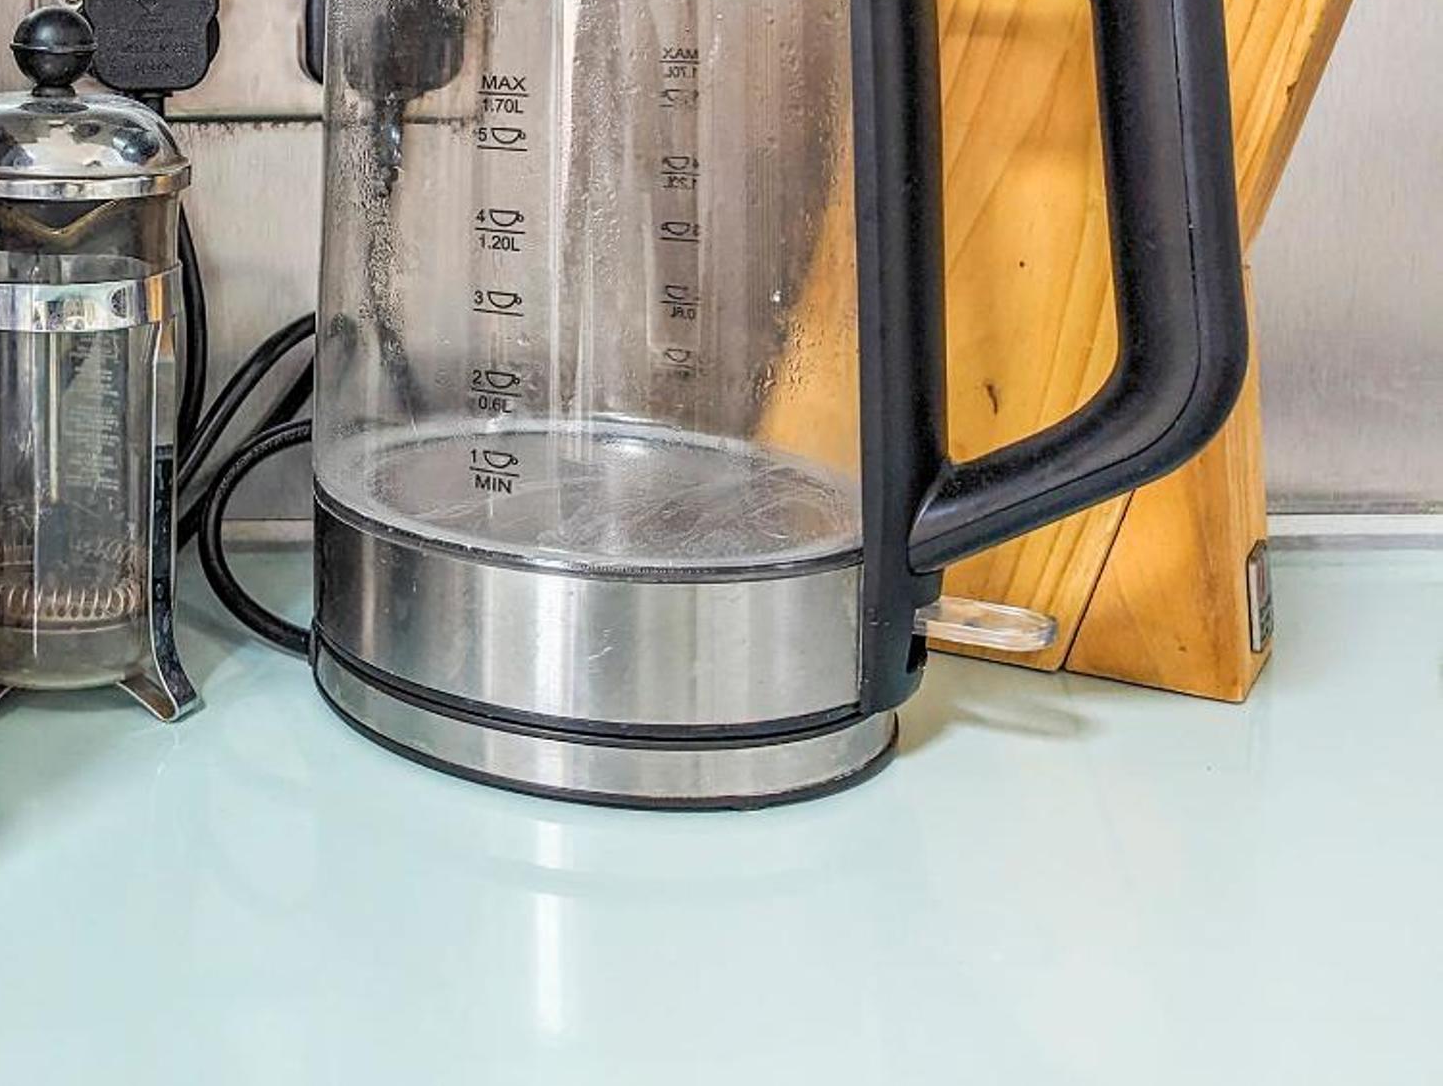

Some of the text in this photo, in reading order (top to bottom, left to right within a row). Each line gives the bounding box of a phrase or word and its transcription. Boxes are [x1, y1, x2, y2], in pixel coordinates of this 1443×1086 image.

[481, 74, 527, 92] MAX
[482, 98, 525, 114] 1.70L
[478, 127, 488, 142] 5
[475, 208, 486, 223] 4
[478, 233, 521, 252] 1.20L
[474, 290, 484, 305] 3
[471, 369, 483, 386] 2
[478, 395, 513, 414] 0.6L
[470, 449, 478, 464] 1
[474, 474, 513, 494] MIN
